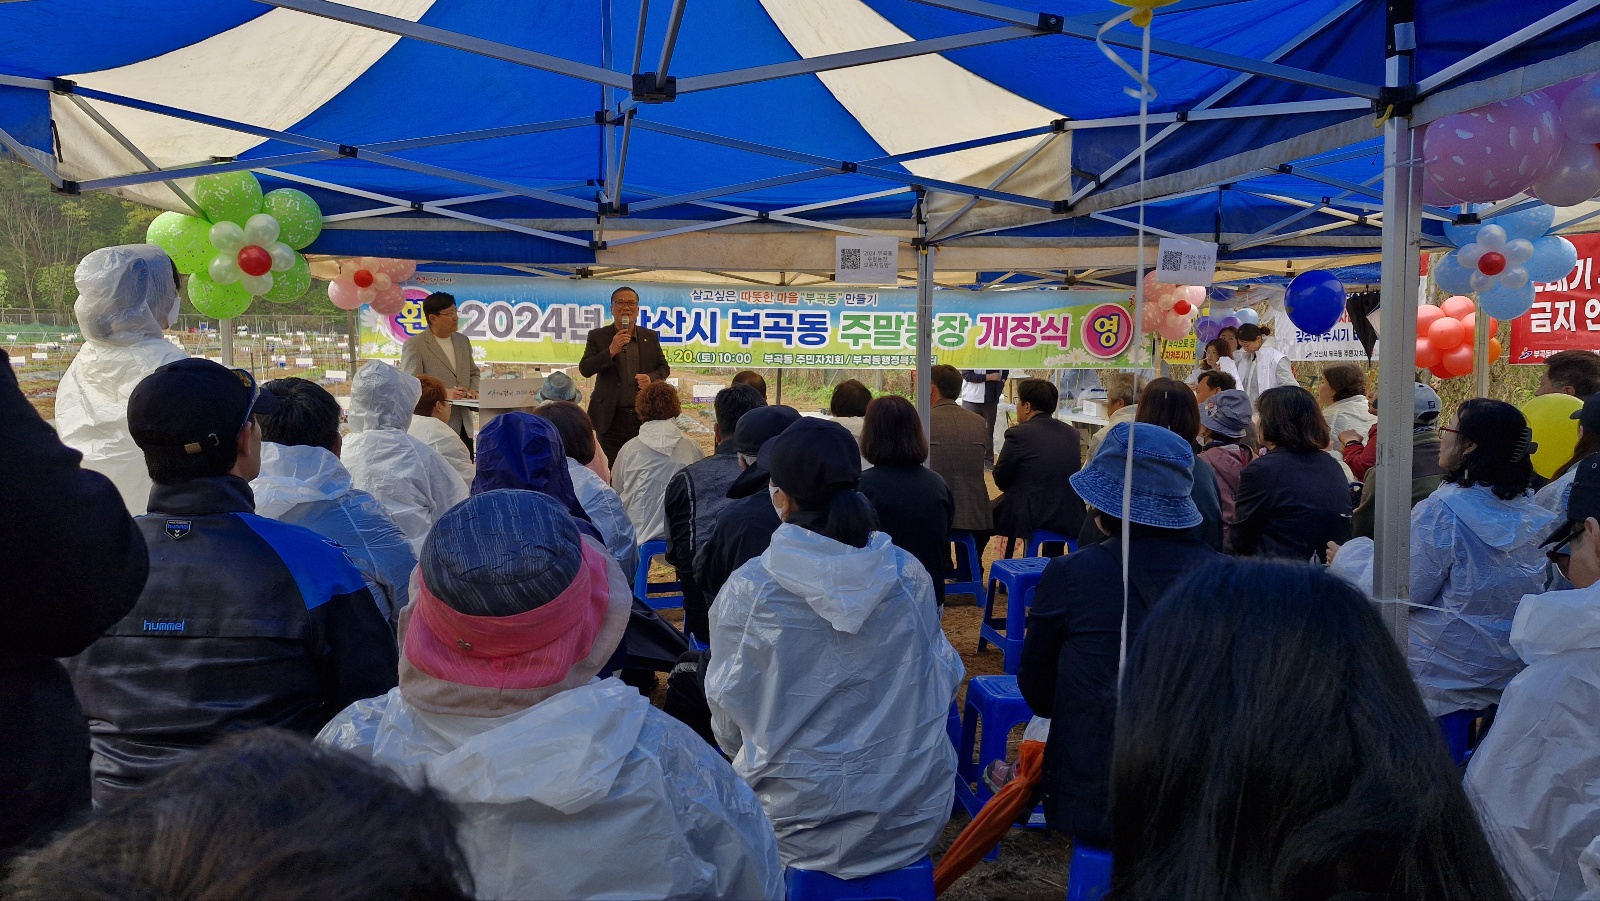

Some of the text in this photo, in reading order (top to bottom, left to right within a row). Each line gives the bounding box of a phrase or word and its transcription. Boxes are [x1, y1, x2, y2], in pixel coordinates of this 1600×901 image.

[692, 288, 736, 302] 살고싶은
[740, 290, 775, 304] 따뜻한
[777, 292, 798, 304] 마을
[845, 293, 877, 306] 만들기
[1530, 299, 1576, 333] 금지
[729, 311, 829, 346] 부곡동
[840, 313, 969, 348] 주말농장
[977, 315, 1069, 348] 개장식
[1094, 314, 1119, 347] 영
[718, 352, 752, 364] 10:00
[763, 353, 794, 365] 부곡동
[795, 354, 844, 366] 주민자치회
[143, 620, 185, 632] hummel
